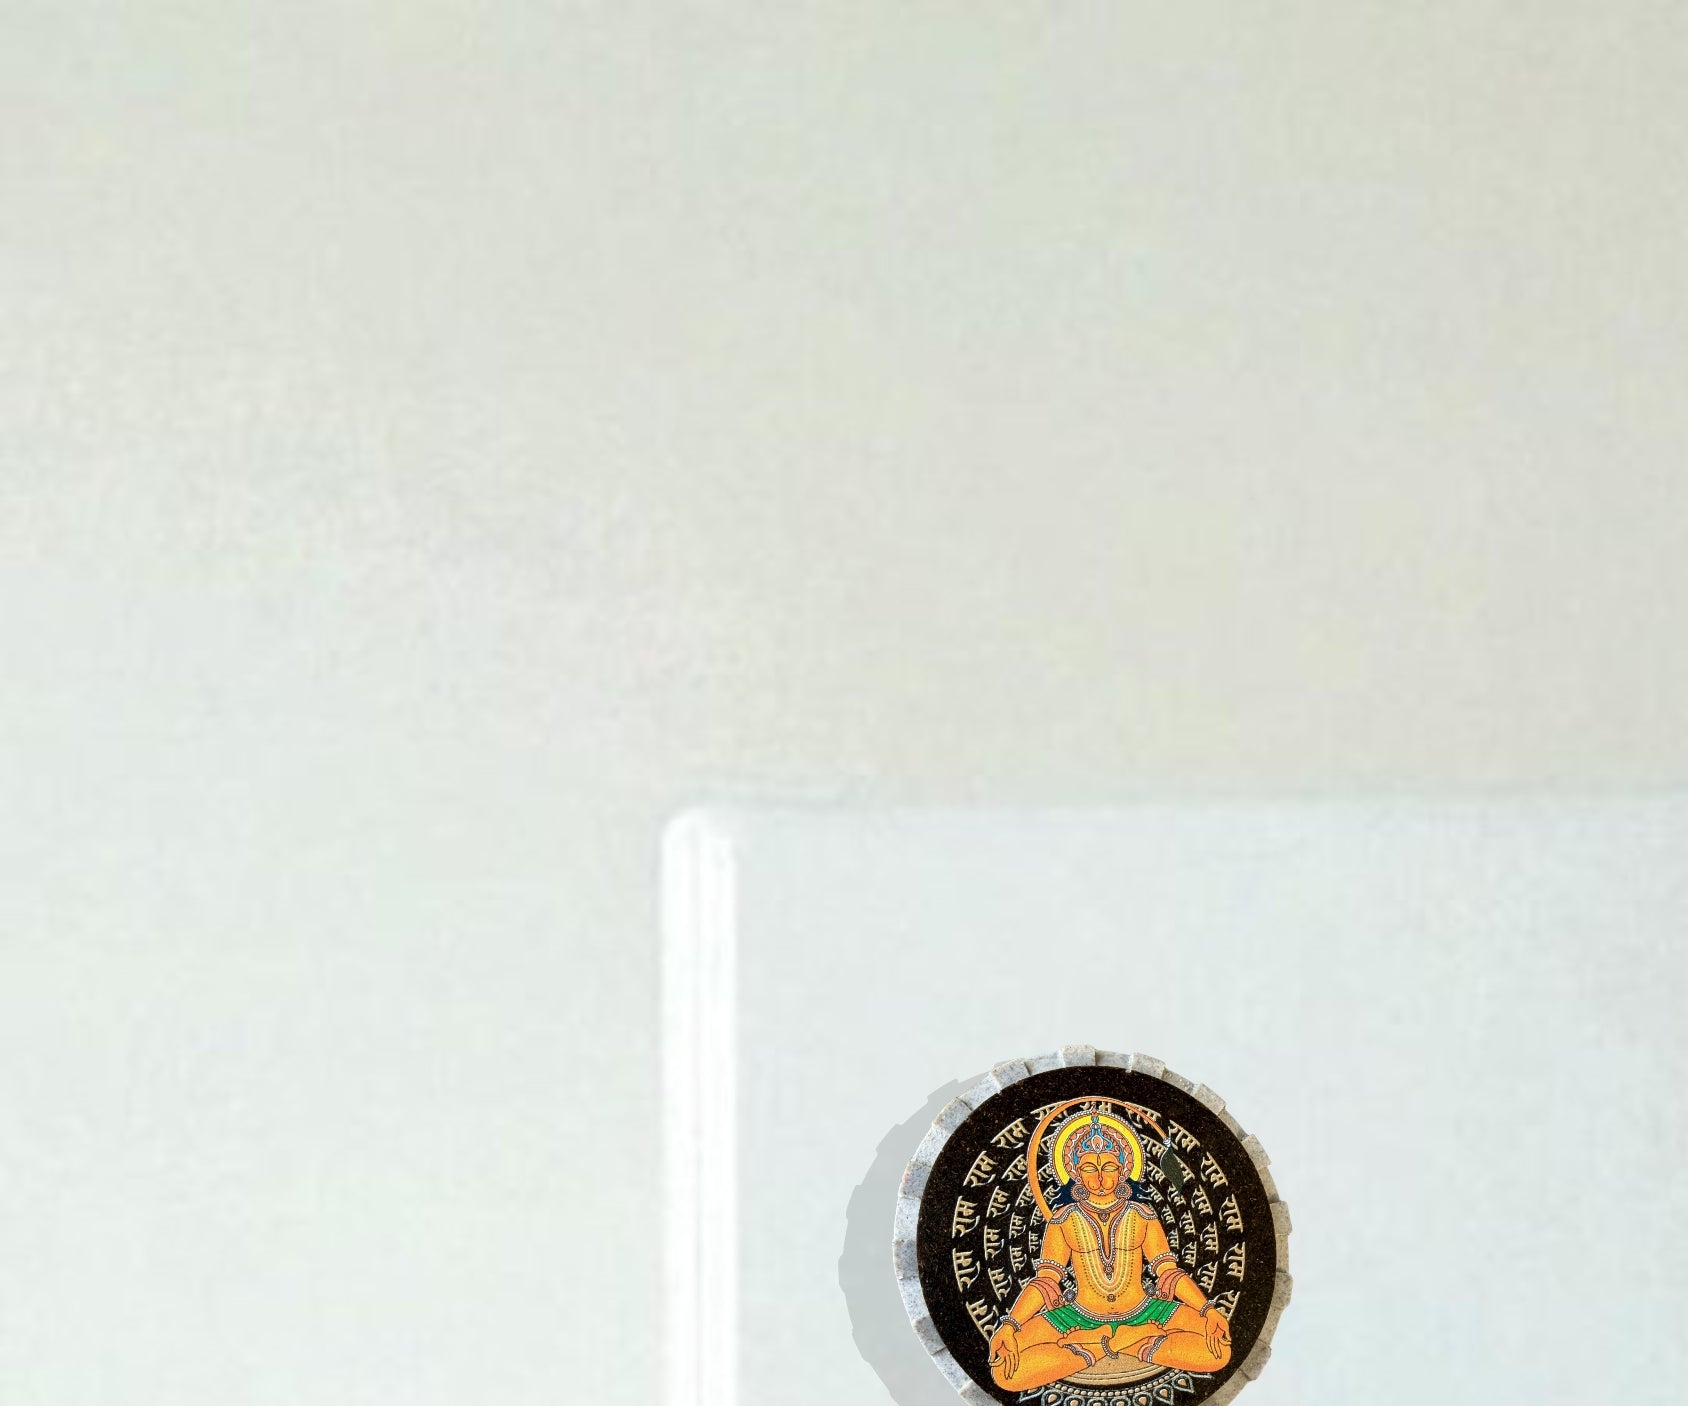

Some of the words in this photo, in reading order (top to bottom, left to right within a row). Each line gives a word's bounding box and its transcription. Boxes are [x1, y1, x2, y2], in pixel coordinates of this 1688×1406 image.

[990, 1118, 1030, 1148] राम
[963, 1151, 998, 1187] राम
[1201, 1152, 1228, 1188] राम
[952, 1195, 980, 1239] राम
[1220, 1194, 1242, 1232] राम
[952, 1248, 980, 1293] राम
[1224, 1242, 1245, 1282] राम
